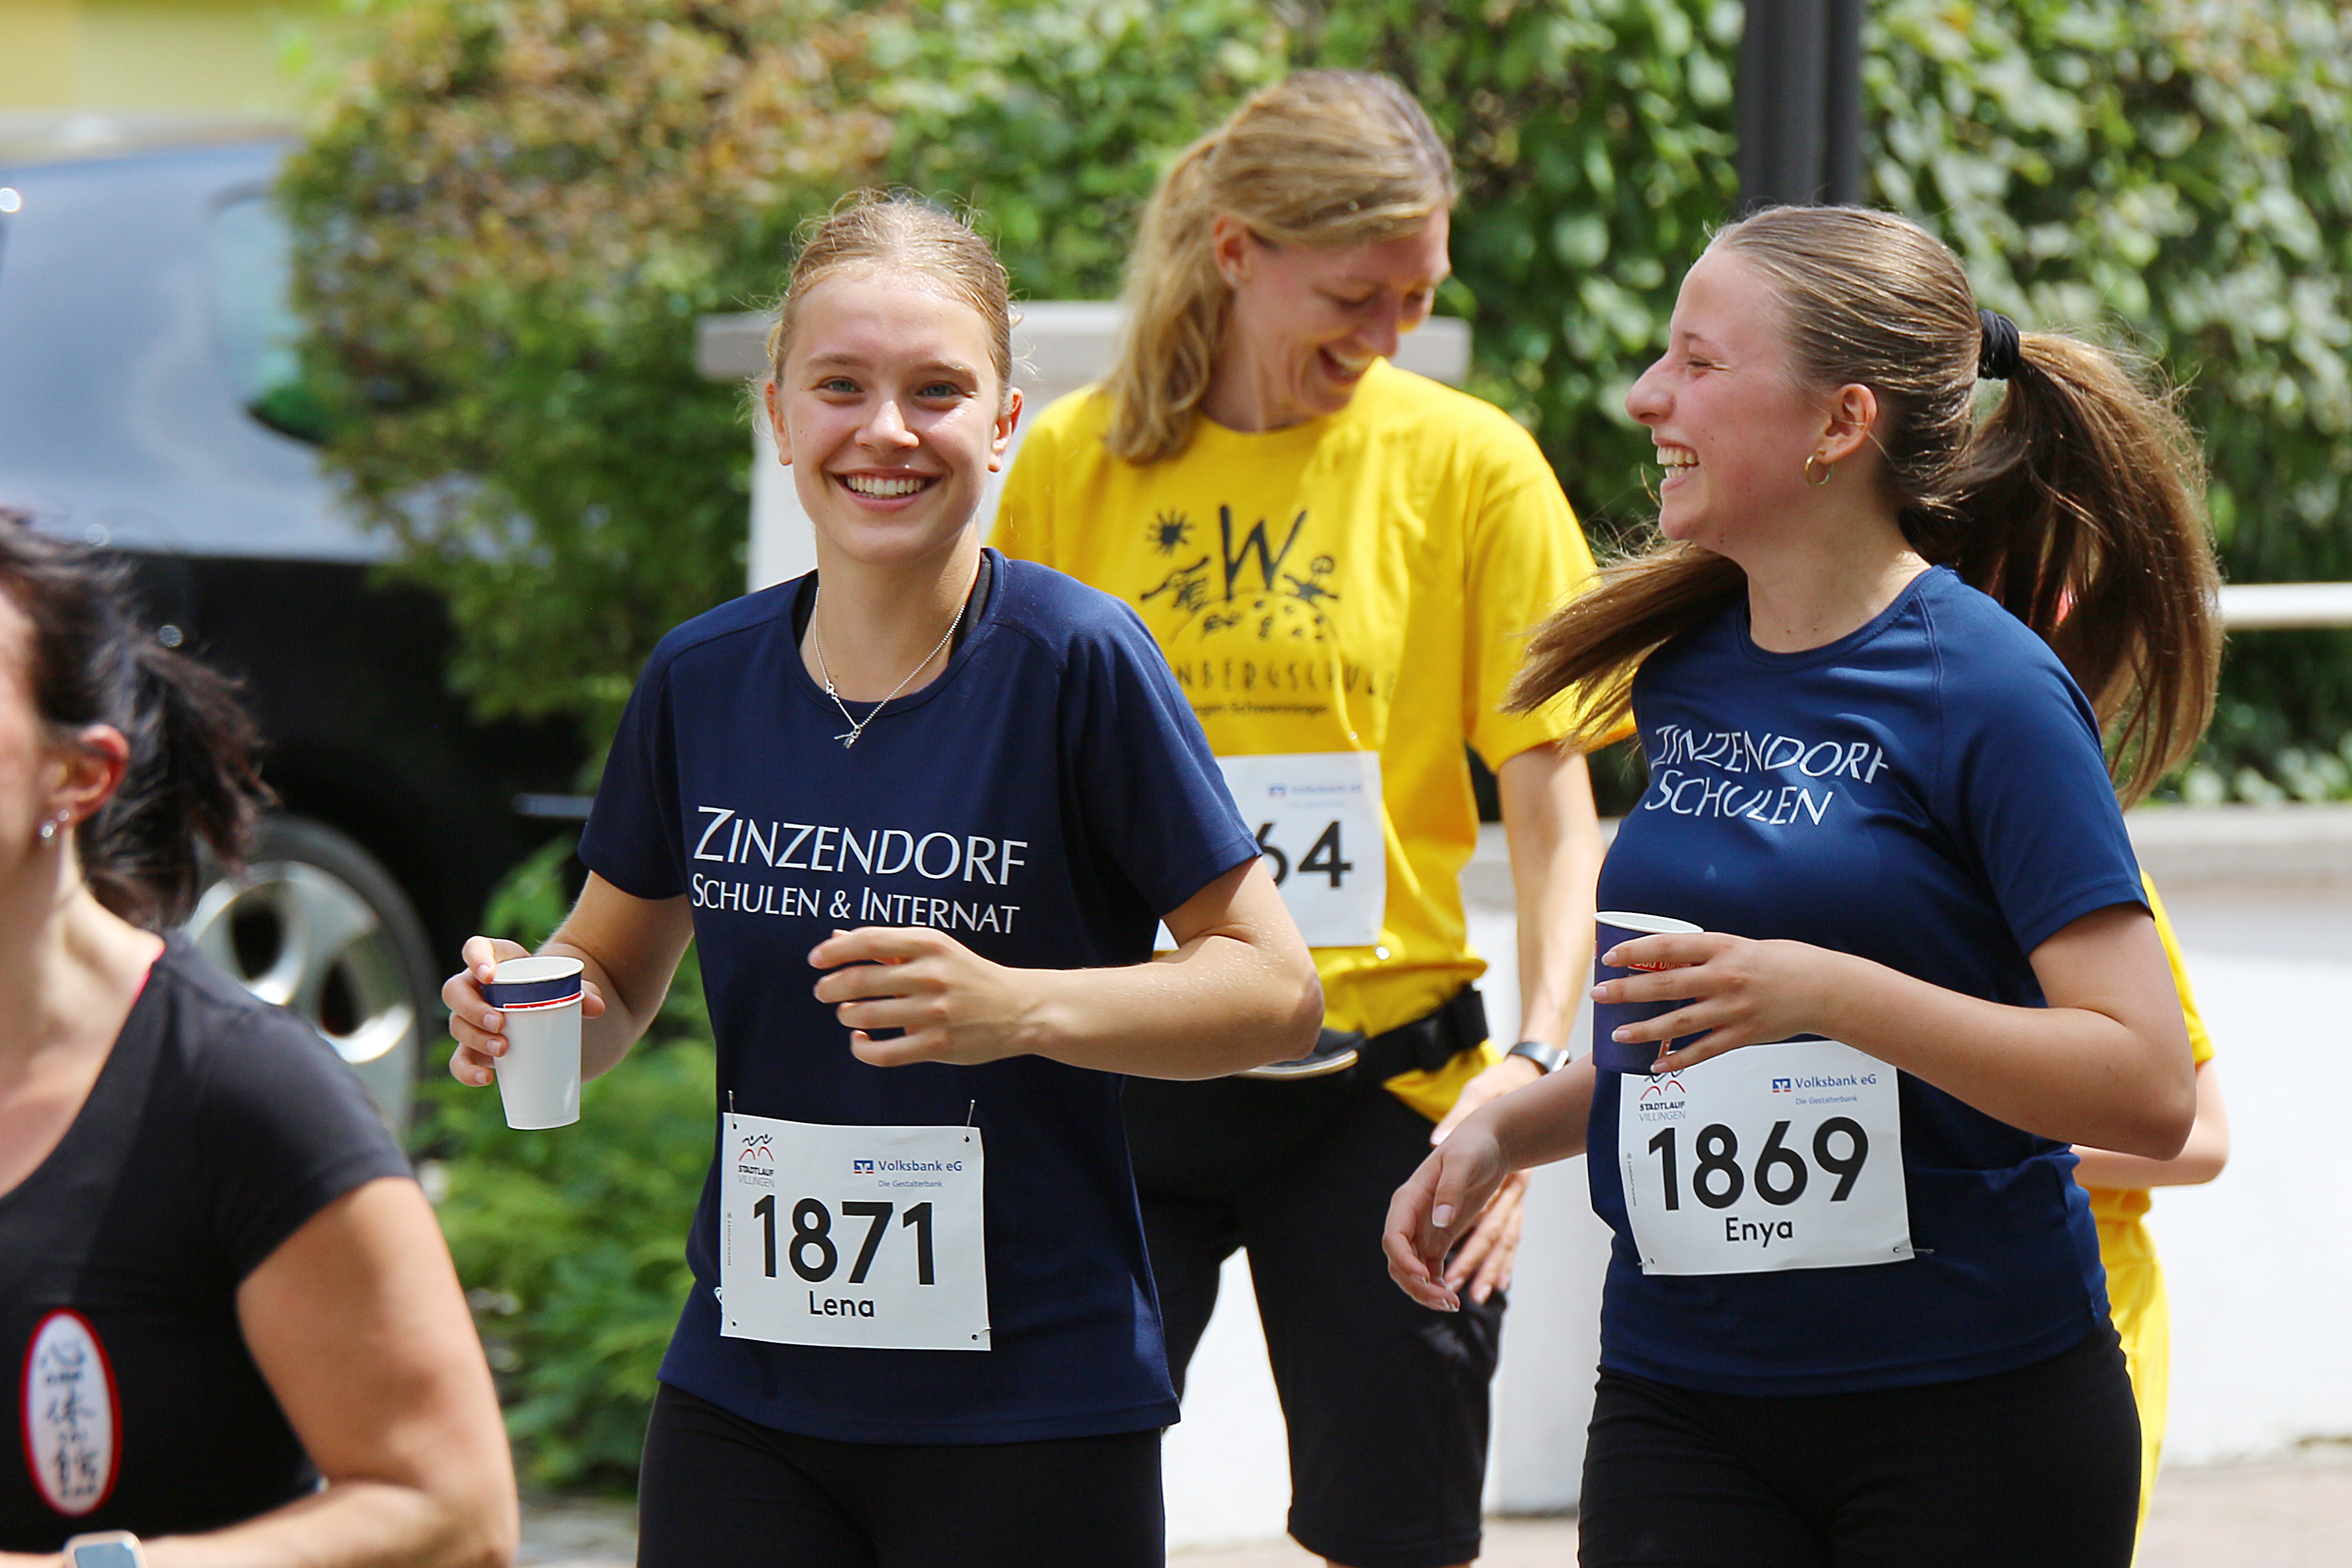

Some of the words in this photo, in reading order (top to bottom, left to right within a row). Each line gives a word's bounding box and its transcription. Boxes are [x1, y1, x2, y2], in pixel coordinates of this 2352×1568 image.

[1650, 724, 1890, 785] ZINZENDORF
[1644, 769, 1834, 826] SCHULEN
[693, 805, 1028, 886] ZINZENDORF
[692, 873, 821, 918] SCHULEN
[828, 890, 850, 919] &
[860, 887, 1020, 934] INTERNAT
[1794, 1074, 1857, 1089] Volksbank
[1861, 1073, 1877, 1085] eG
[1639, 1101, 1686, 1111] STADTLAUF
[1639, 1111, 1686, 1121] VILLINGEN
[738, 1165, 775, 1176] STADTLAUF
[878, 1160, 943, 1172] Volksbank
[946, 1160, 963, 1172] eG
[1648, 1117, 1869, 1212] 1869
[738, 1174, 775, 1188] VILLINGEN
[753, 1194, 935, 1286] 1871
[1726, 1217, 1794, 1248] Enya
[809, 1291, 876, 1318] Lena
